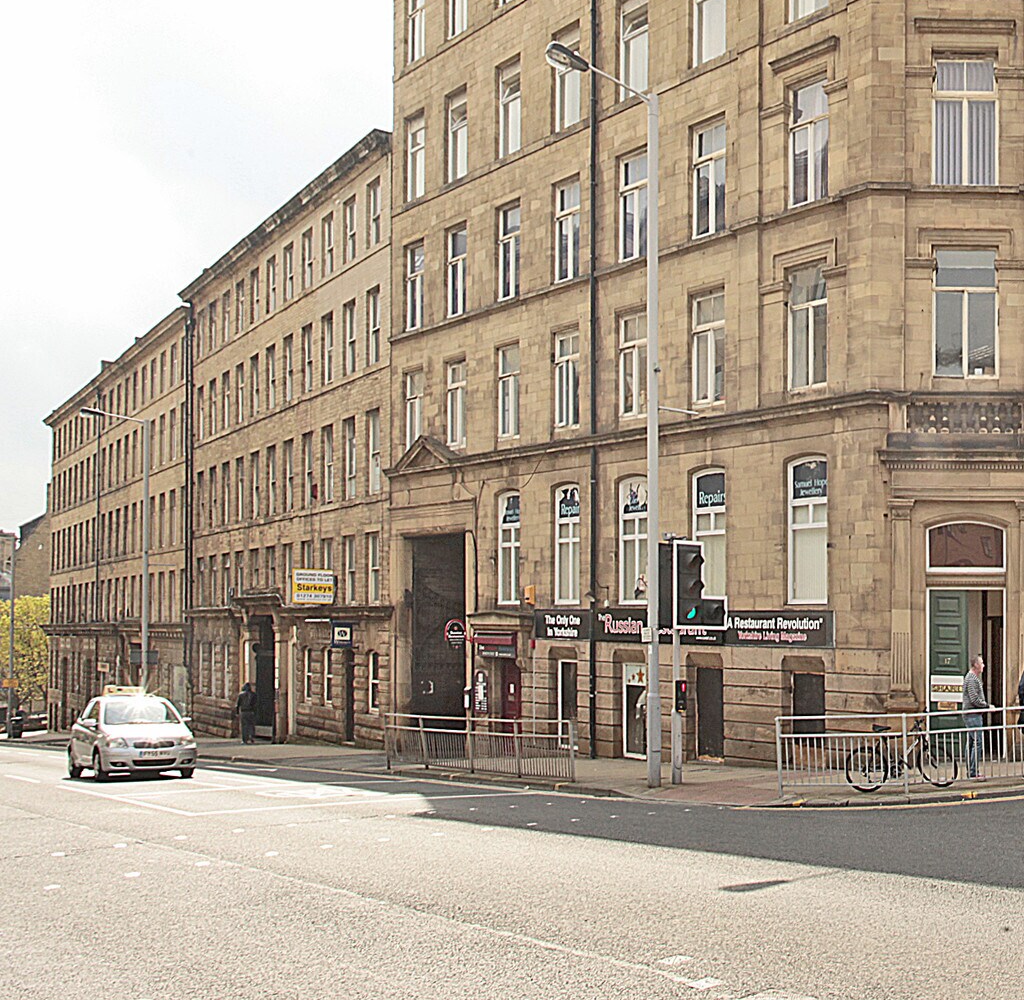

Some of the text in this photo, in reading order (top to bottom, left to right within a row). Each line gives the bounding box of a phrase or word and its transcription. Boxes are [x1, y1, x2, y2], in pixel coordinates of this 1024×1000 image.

[297, 583, 332, 593] Starkeys
[544, 614, 581, 627] The Only One
[604, 613, 644, 635] Russian
[735, 616, 773, 630] Restaurant
[553, 627, 579, 638] Yorkshire
[763, 630, 780, 643] Living
